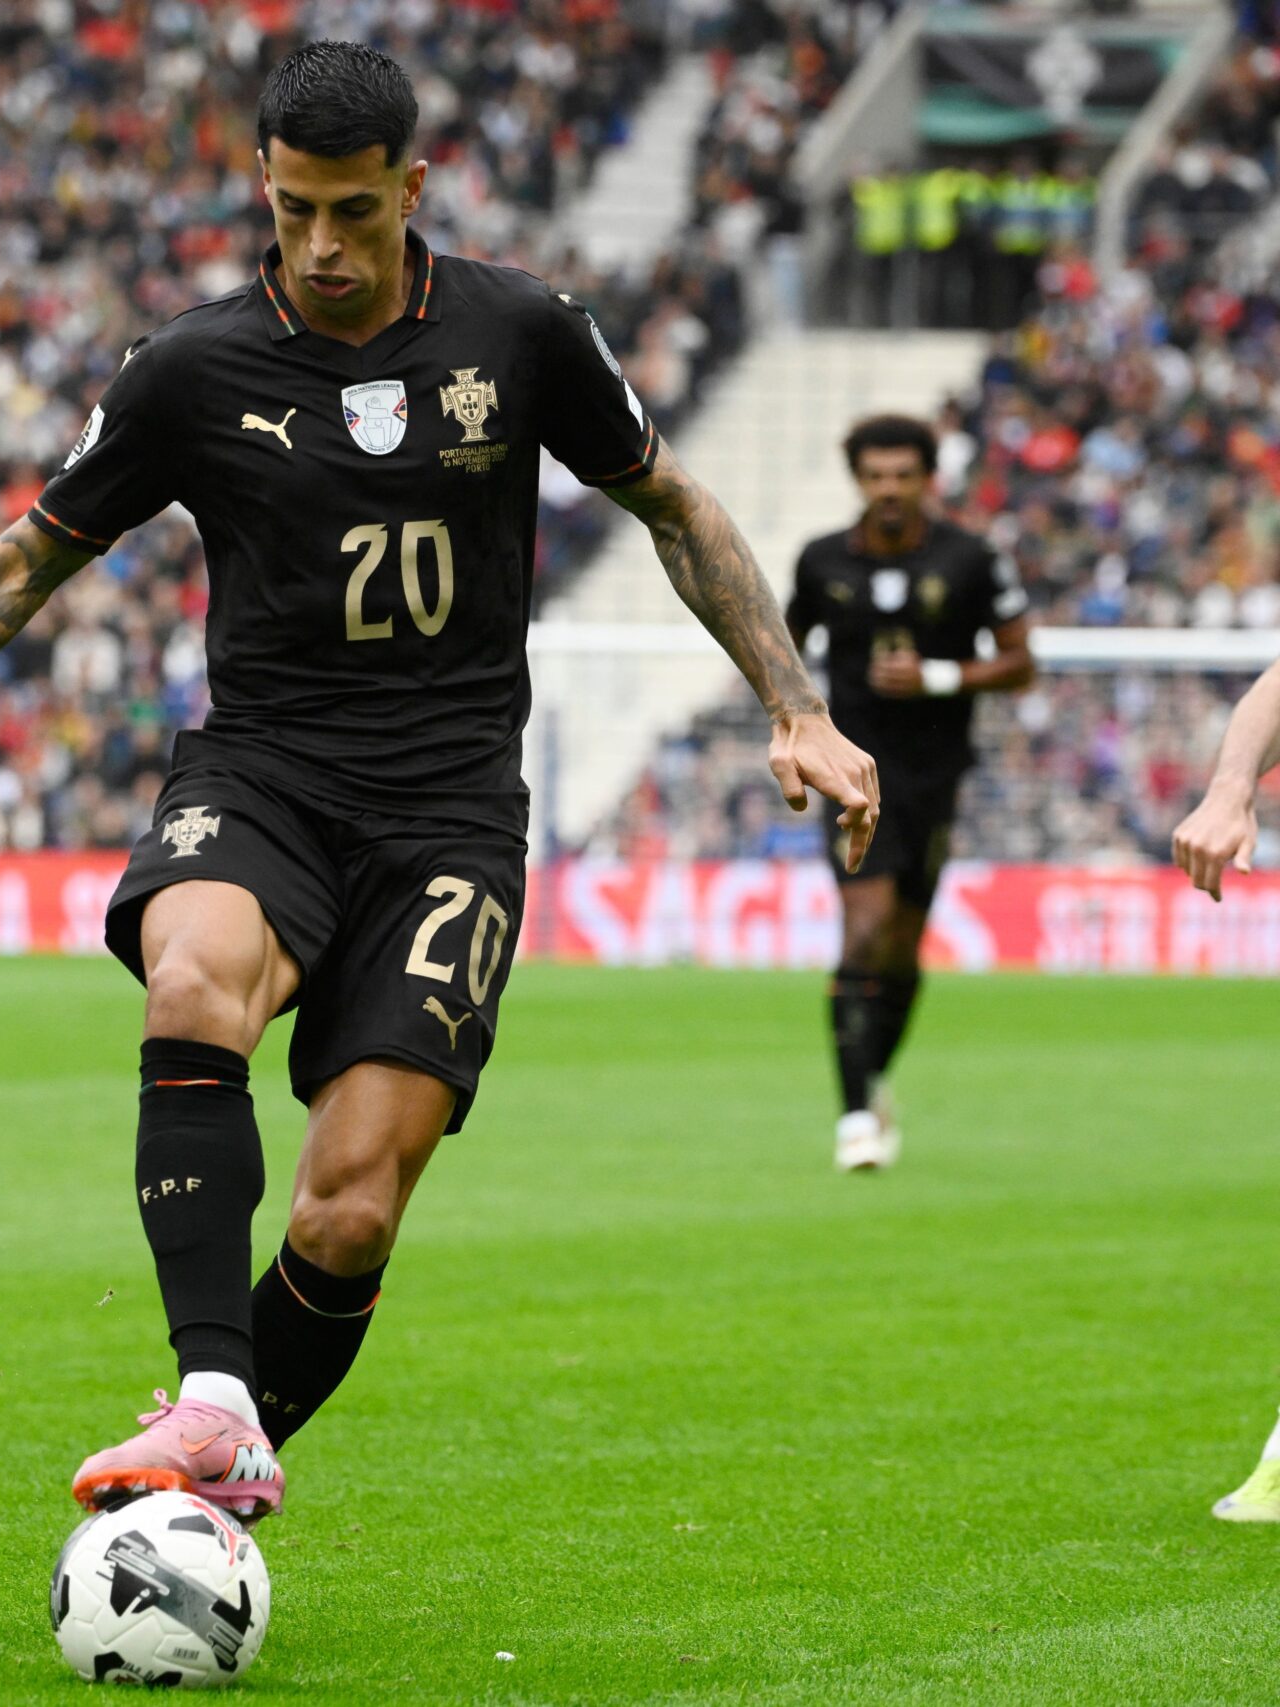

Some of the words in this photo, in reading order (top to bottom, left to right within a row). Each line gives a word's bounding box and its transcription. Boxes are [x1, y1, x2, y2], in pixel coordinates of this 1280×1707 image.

[452, 453, 491, 466] NOVEMBRO
[465, 462, 491, 473] PORTO
[340, 519, 454, 642] 20
[404, 875, 509, 1007] 20
[561, 853, 1000, 975] SAGRS
